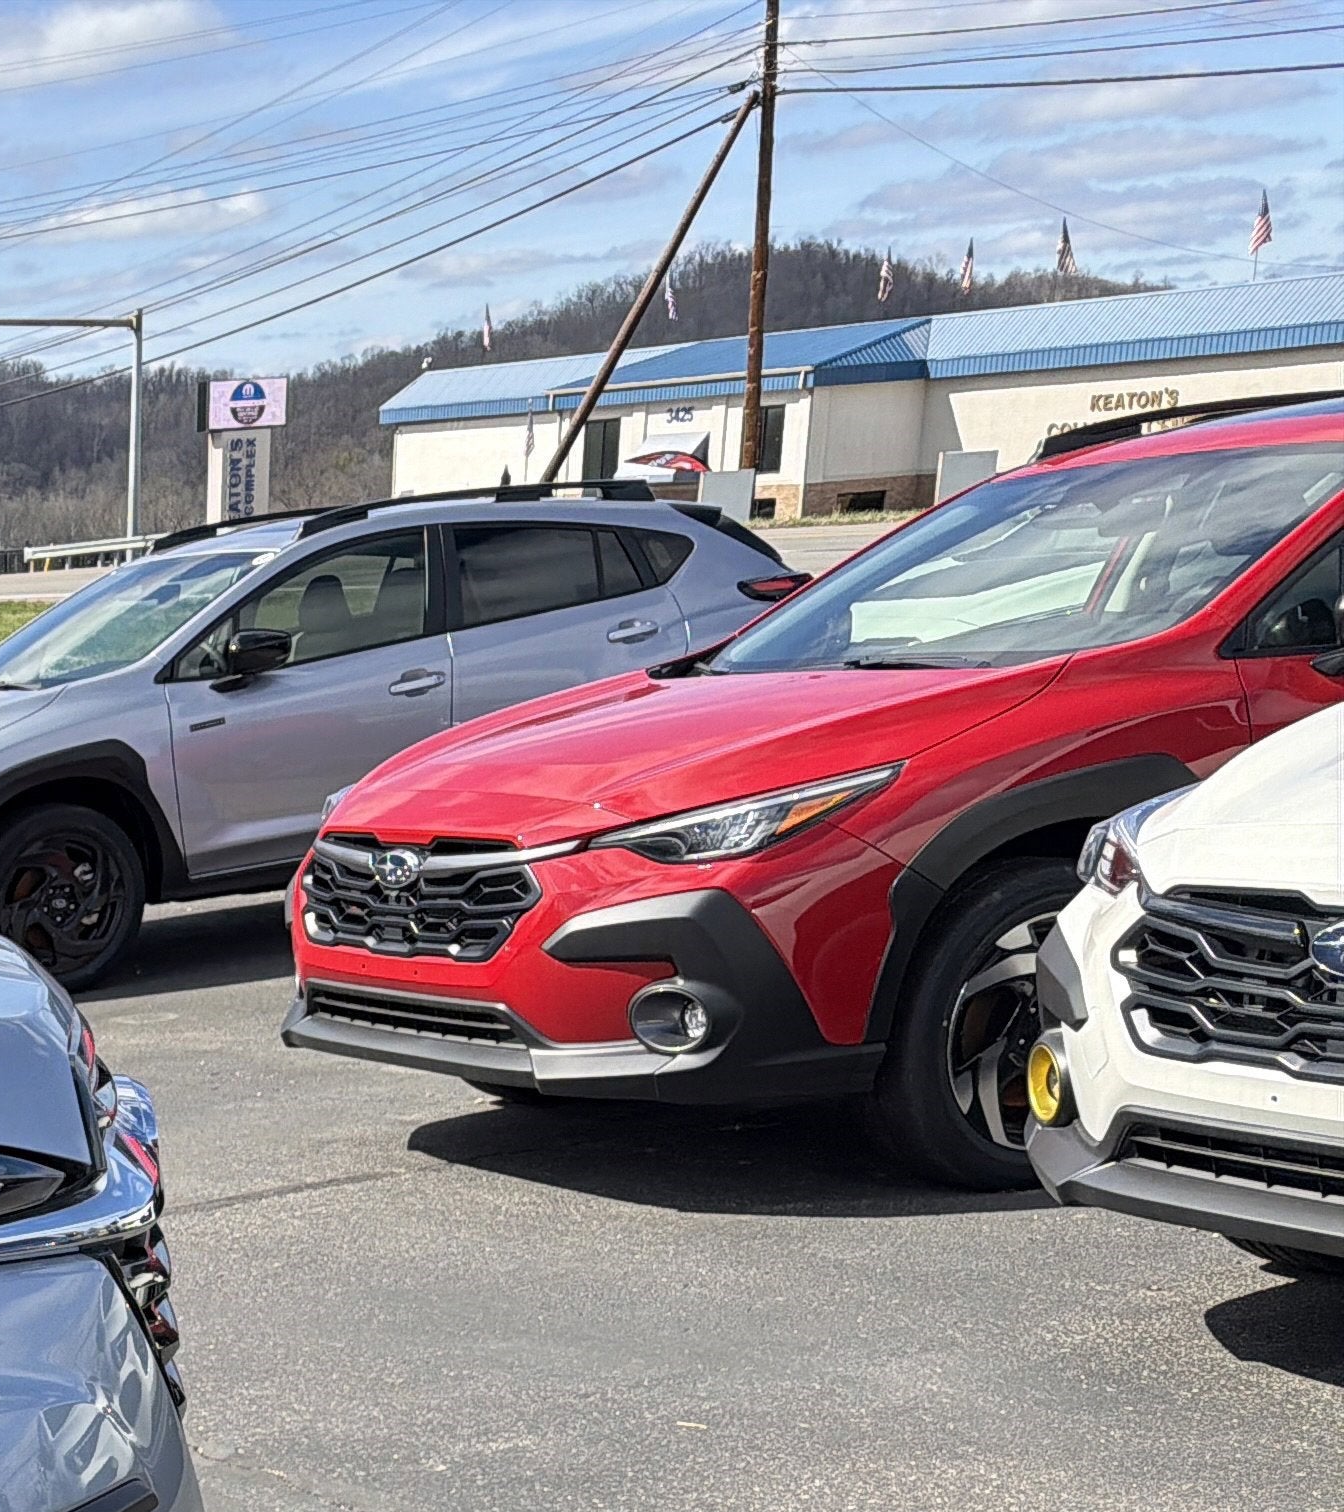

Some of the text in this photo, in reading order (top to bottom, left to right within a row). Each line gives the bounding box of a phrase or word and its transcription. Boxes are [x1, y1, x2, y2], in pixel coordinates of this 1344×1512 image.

[1089, 387, 1180, 413] KEATON'S
[666, 406, 695, 424] 3425
[244, 437, 257, 515] COMPLEX
